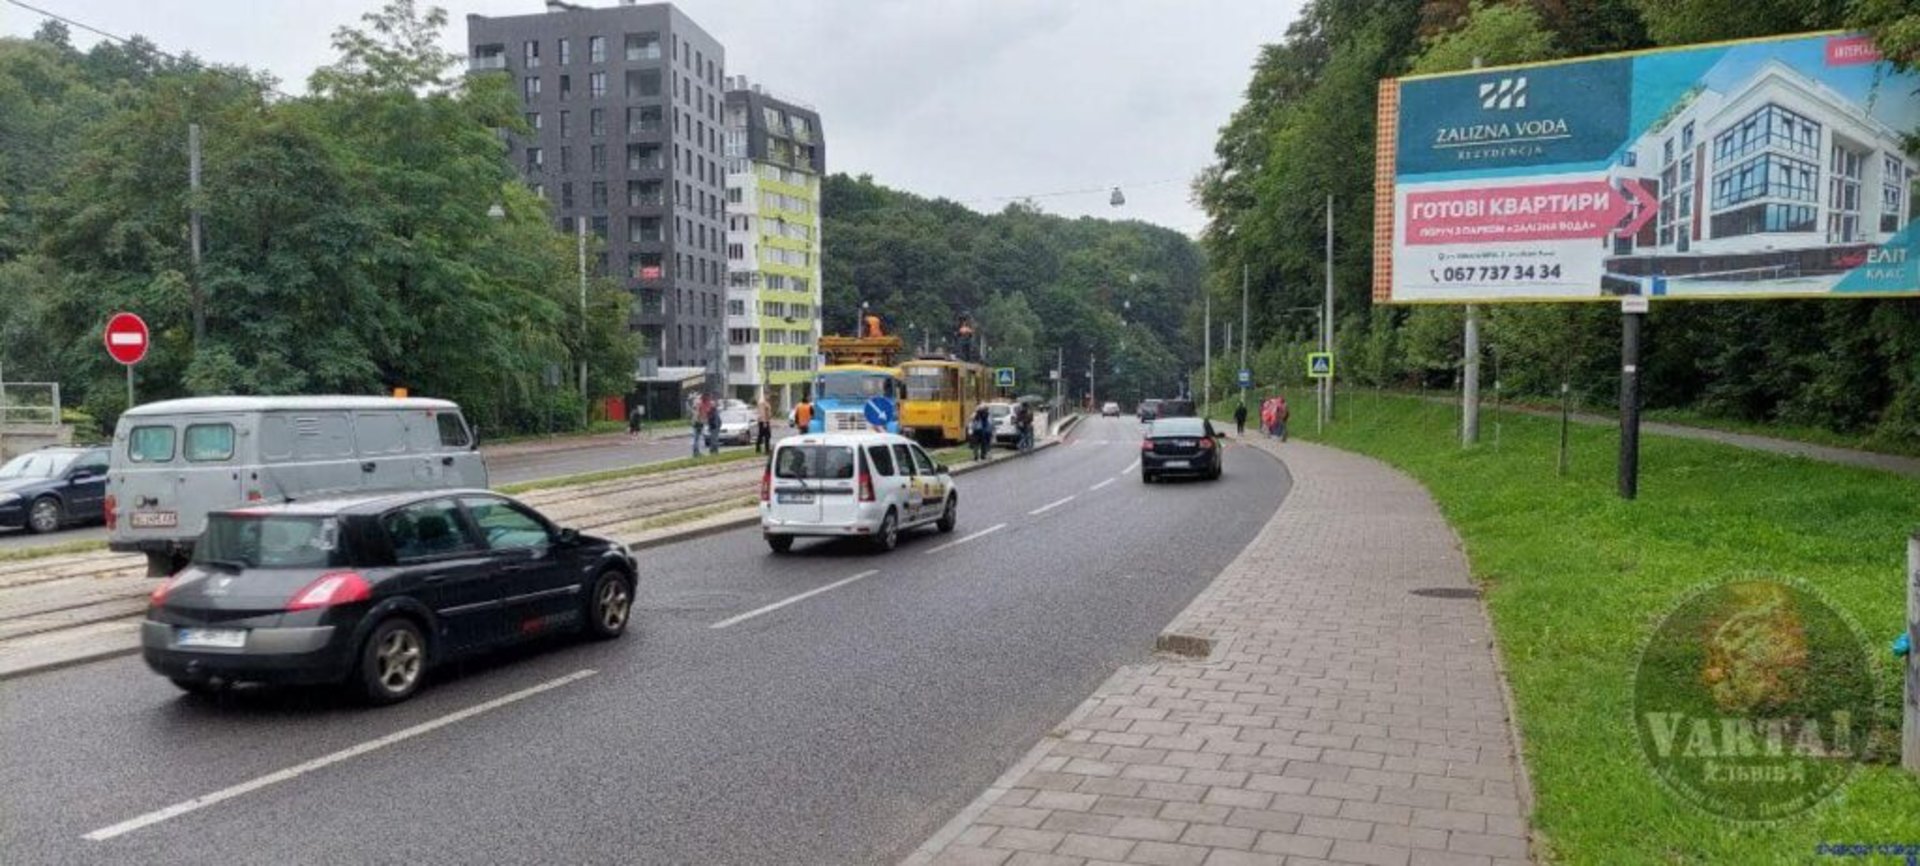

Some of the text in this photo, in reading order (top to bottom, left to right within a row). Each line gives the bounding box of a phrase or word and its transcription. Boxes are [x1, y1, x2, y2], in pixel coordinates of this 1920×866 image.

[1437, 118, 1567, 142] ZALIZNA VODA
[1412, 192, 1610, 219] ГОТОВІ КВАРТИРИ
[1444, 263, 1561, 281] 067 737 34 34
